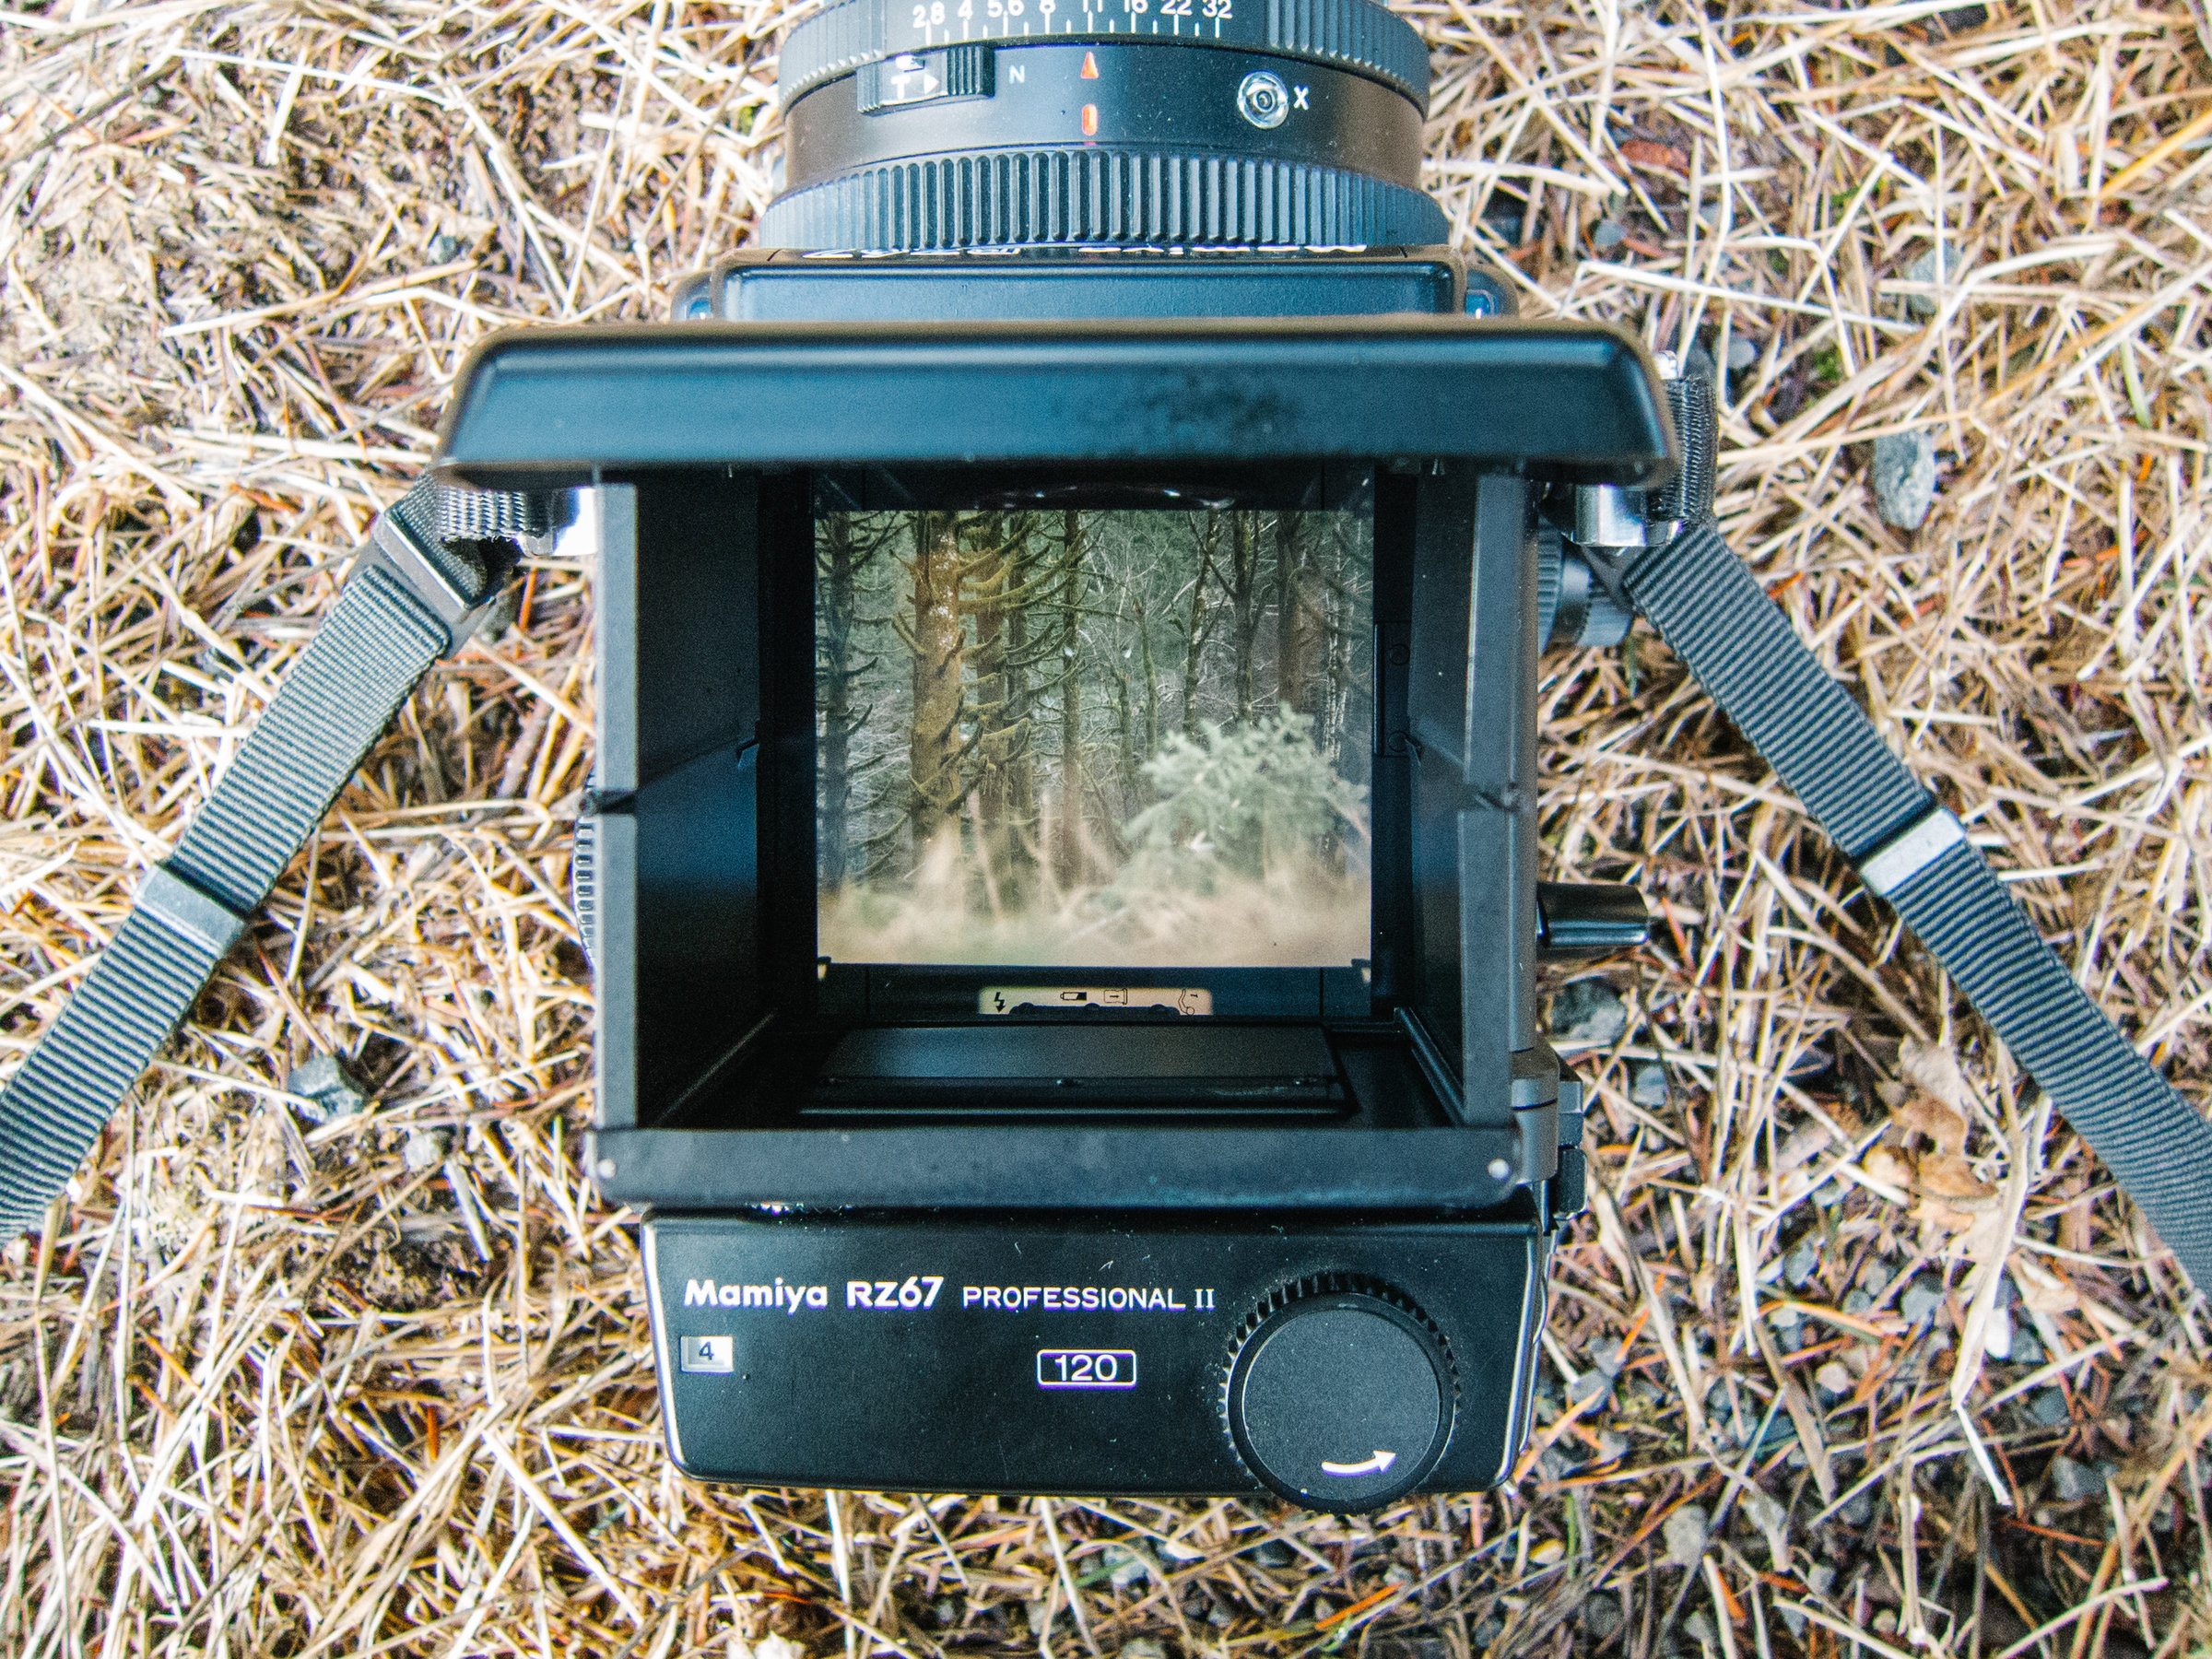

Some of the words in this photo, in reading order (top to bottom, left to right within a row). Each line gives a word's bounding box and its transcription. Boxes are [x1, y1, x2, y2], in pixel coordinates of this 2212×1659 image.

[958, 0, 973, 20] 4
[1159, 0, 1193, 16] 22
[1202, 0, 1233, 19] 32
[1008, 65, 1026, 85] N
[1293, 84, 1310, 111] X
[682, 1277, 828, 1316] Mamiya
[845, 1276, 945, 1311] RZ67
[962, 1286, 1186, 1312] PROFESSIONAL
[1194, 1288, 1216, 1312] II
[698, 1340, 714, 1361] 4
[1054, 1354, 1118, 1382] 120
